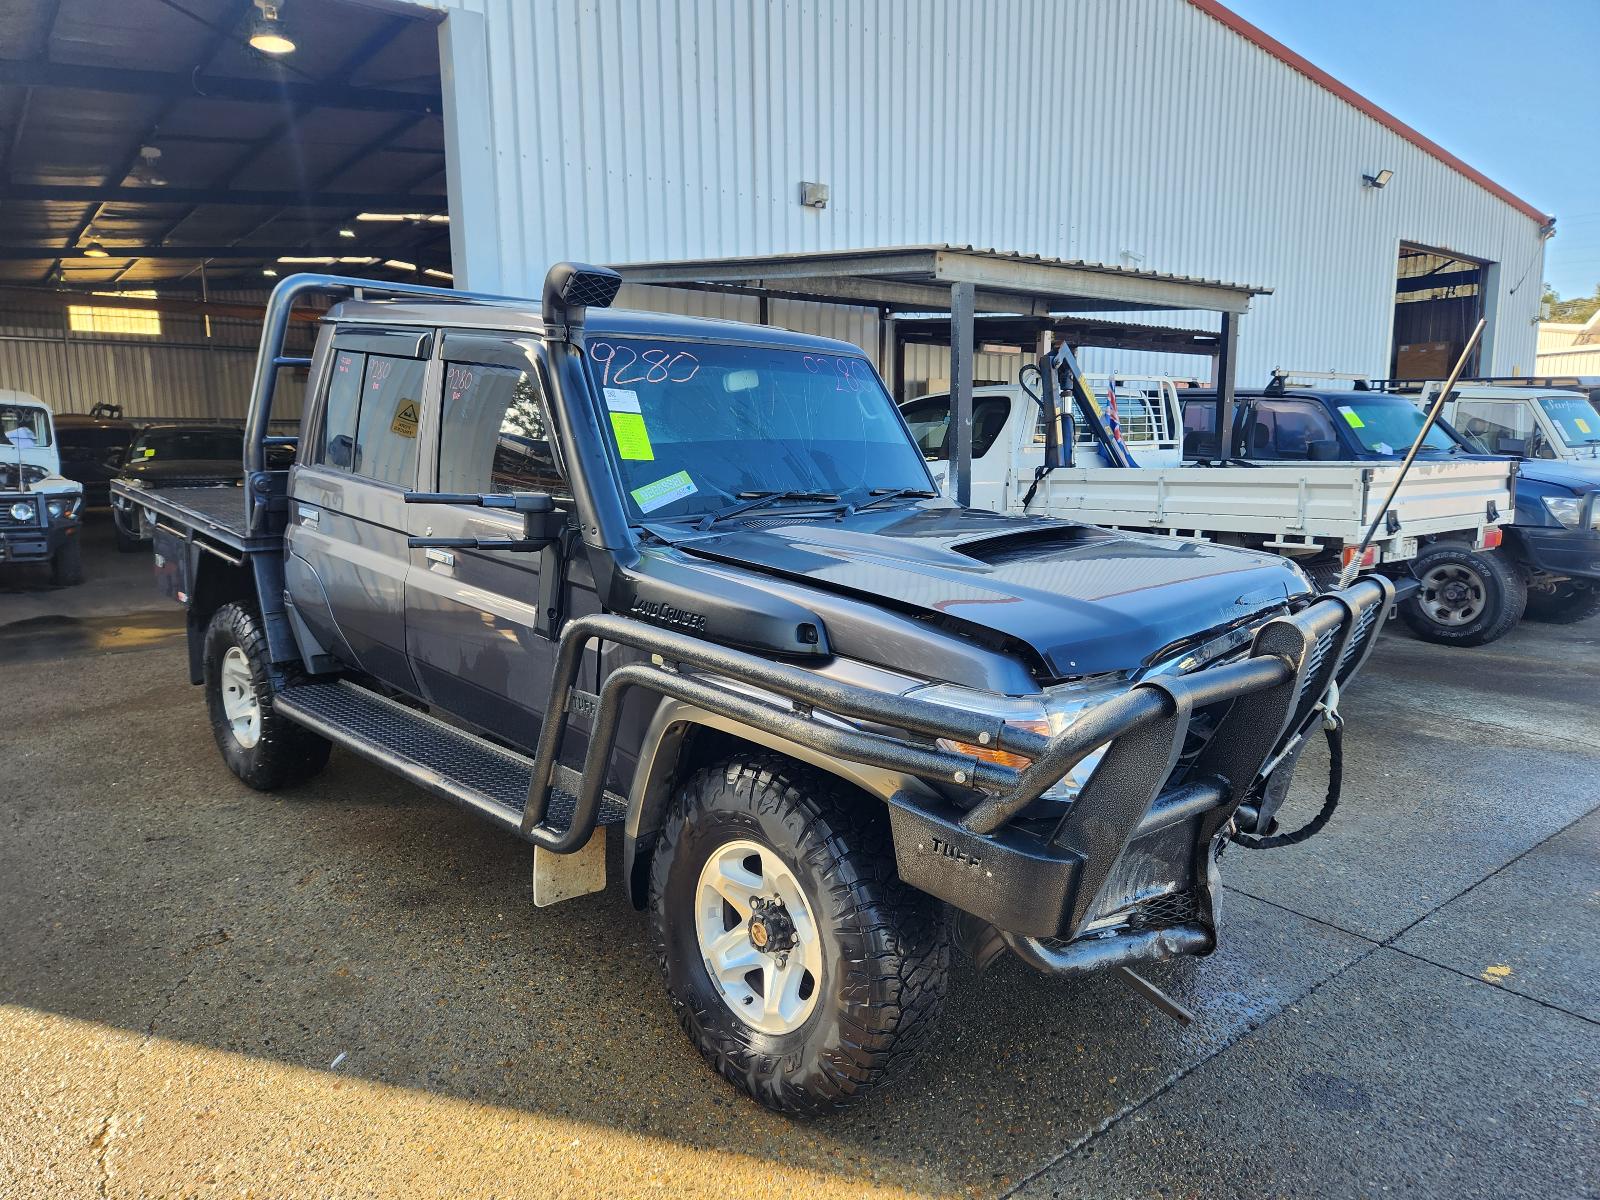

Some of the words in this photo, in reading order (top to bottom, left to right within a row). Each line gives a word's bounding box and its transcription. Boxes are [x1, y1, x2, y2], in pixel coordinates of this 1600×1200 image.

[368, 359, 391, 380] 9280
[591, 342, 699, 386] 9280
[448, 368, 473, 391] 9280
